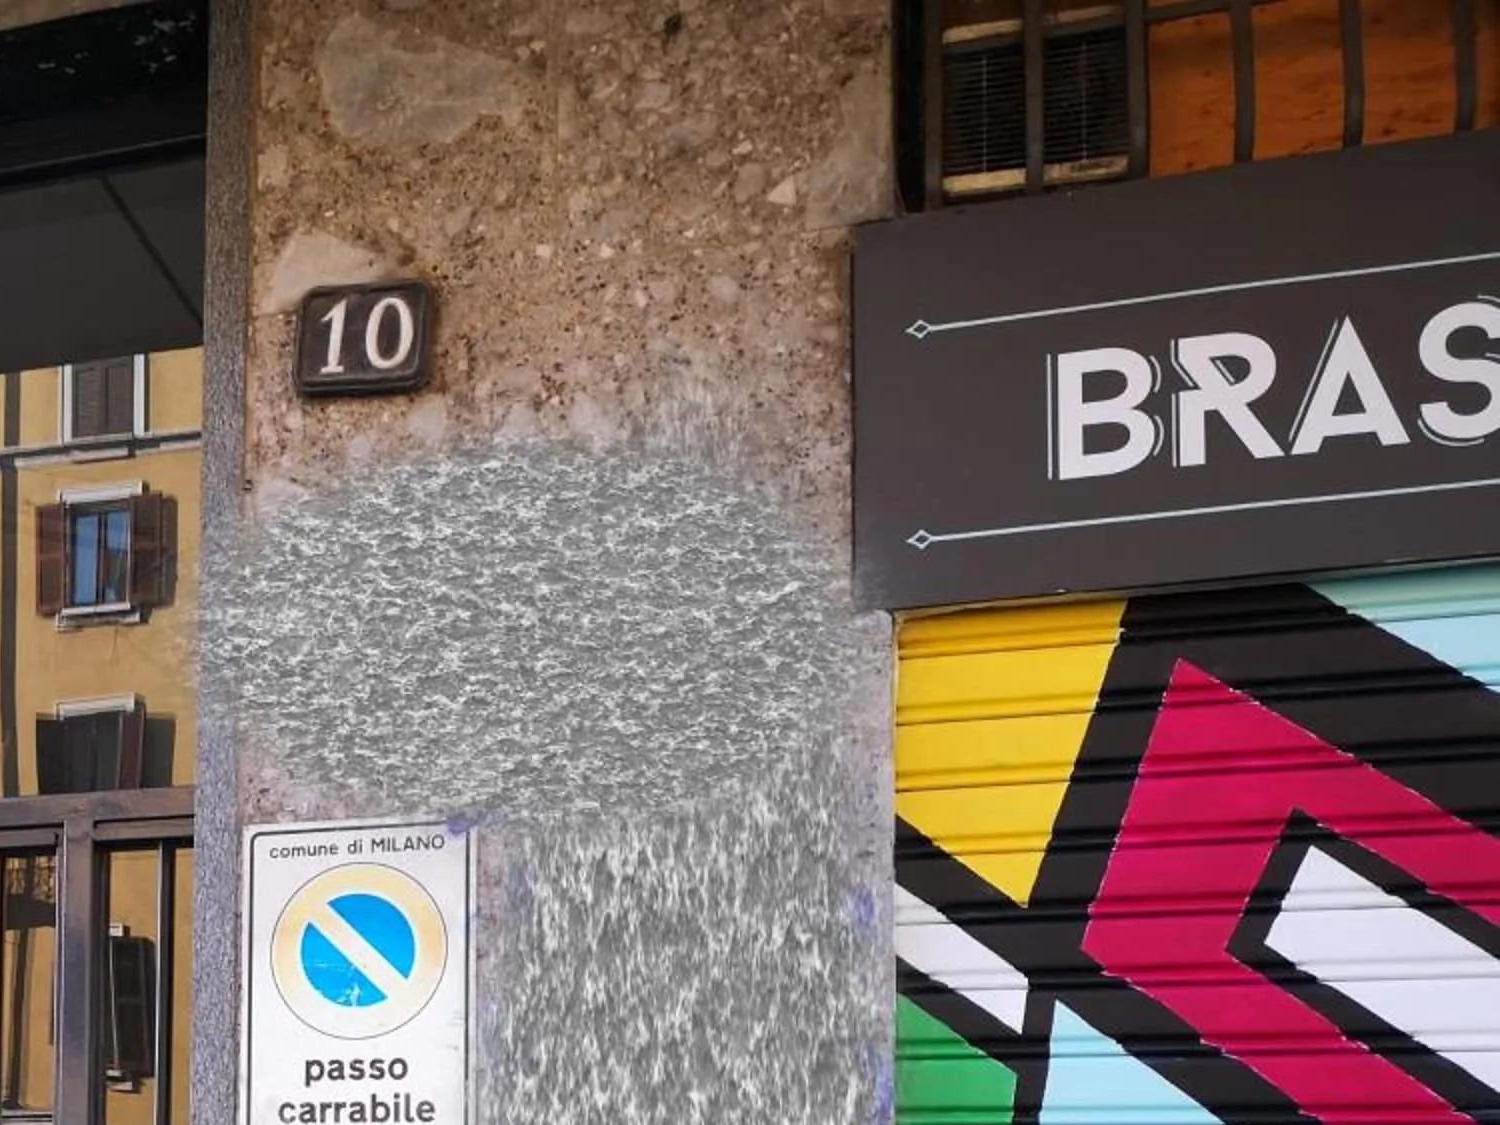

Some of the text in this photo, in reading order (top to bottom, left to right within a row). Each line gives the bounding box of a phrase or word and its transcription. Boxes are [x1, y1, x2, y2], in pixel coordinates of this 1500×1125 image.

[319, 297, 414, 374] 10
[1046, 294, 1500, 481] BRAS
[269, 833, 446, 859] comune di MILANO
[304, 1057, 409, 1088] passo
[278, 1092, 436, 1124] carrabile
